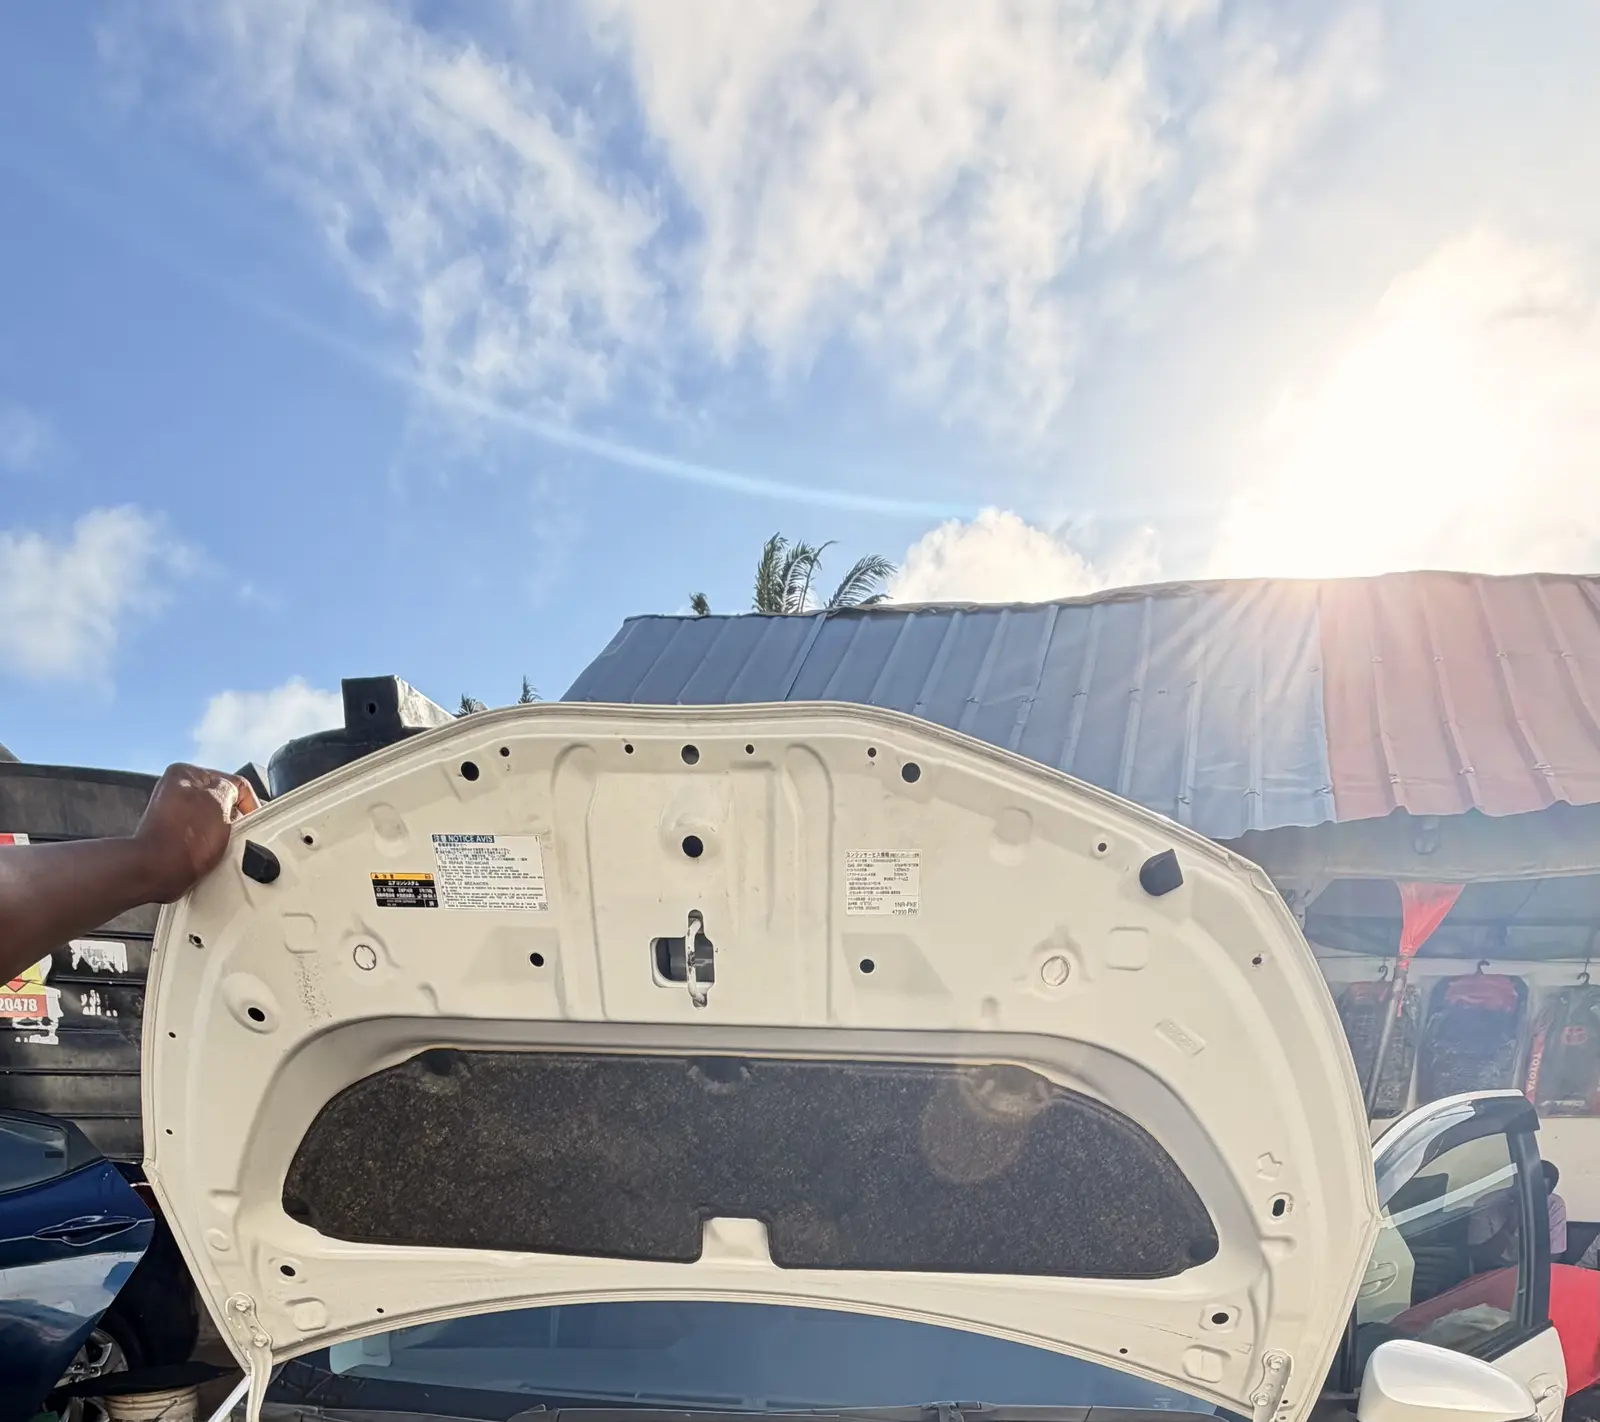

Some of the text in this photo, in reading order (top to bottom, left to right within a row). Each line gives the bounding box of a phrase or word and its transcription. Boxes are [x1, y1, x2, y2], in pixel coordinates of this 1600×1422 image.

[448, 835, 475, 843] NOTICE
[476, 835, 493, 843] AVIS
[0, 998, 38, 1012] 20478
[1527, 1052, 1543, 1092] TOYOTA
